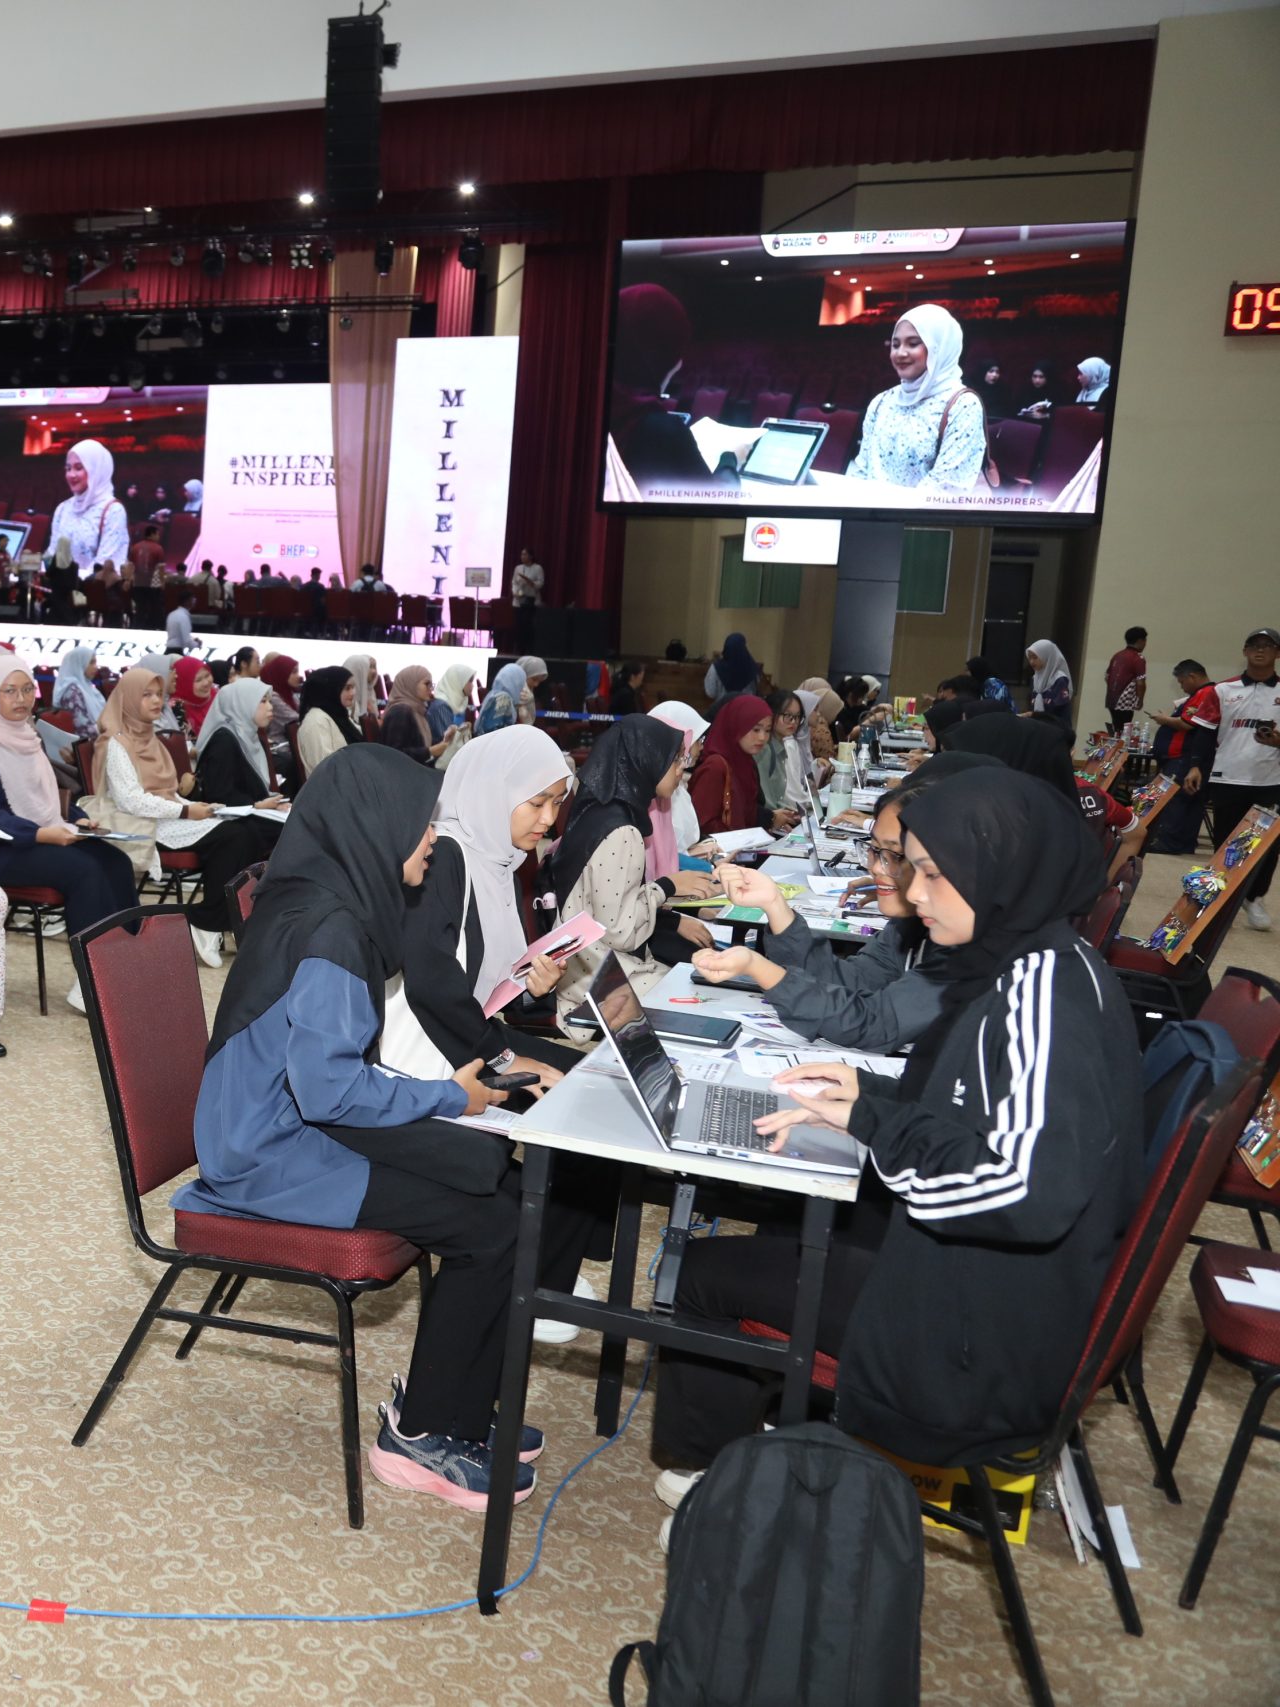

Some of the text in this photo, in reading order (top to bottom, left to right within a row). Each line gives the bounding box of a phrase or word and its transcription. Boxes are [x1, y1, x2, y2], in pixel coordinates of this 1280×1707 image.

[854, 232, 878, 244] BHEP
[229, 455, 335, 469] #MILLENI
[232, 471, 336, 486] INSPIRER
[430, 388, 466, 596] MILLENI
[648, 489, 753, 499] #MILLENIAINSPIRERS
[926, 496, 1043, 506] #MILLENIAINSPIRERS
[280, 544, 305, 556] BHEP
